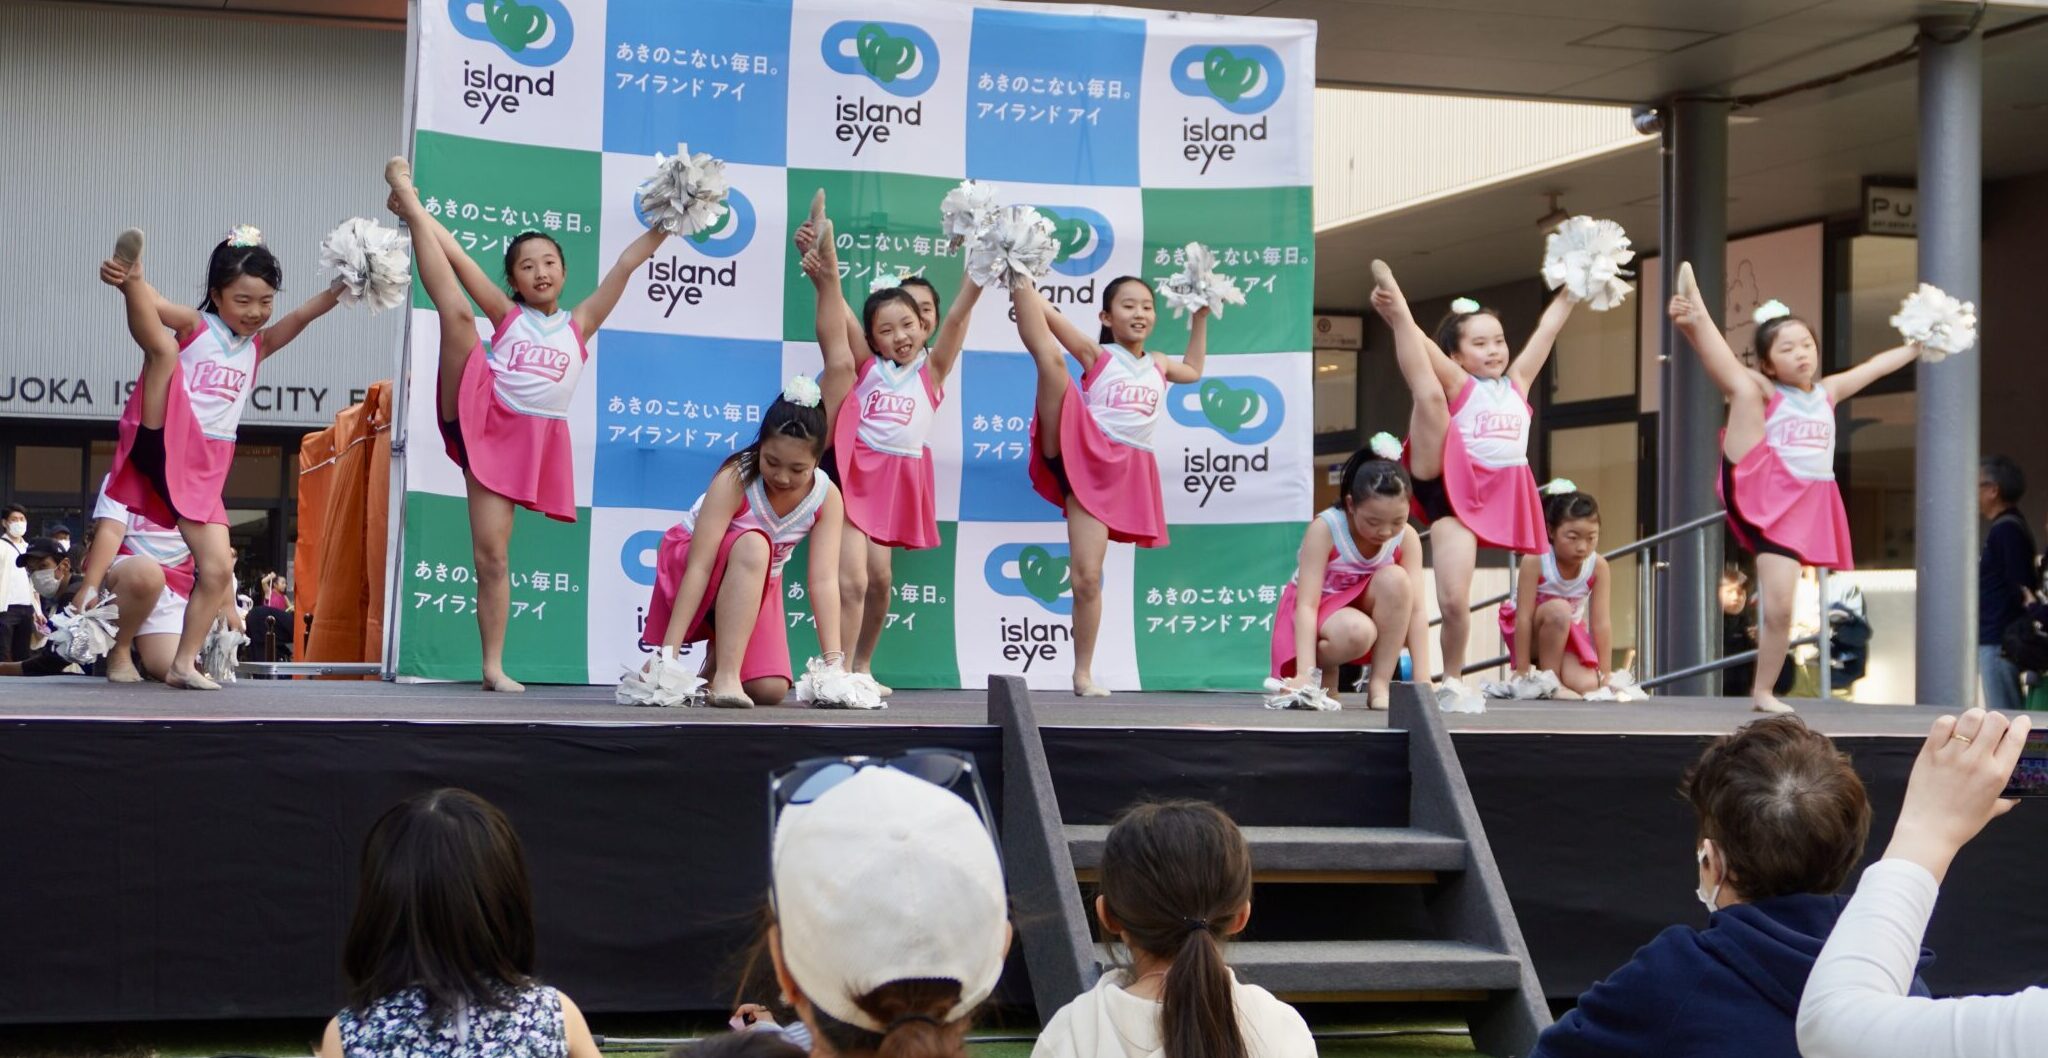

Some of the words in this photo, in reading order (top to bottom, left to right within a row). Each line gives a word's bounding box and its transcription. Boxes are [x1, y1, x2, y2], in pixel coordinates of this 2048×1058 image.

[616, 42, 778, 76] あきのこない毎日。
[463, 60, 555, 97] island
[615, 72, 705, 98] アイランド
[711, 82, 745, 101] アイ
[977, 72, 1132, 99] あきのこない毎日。
[463, 90, 520, 125] eye
[836, 95, 922, 126] island
[977, 102, 1060, 124] アイランド
[1068, 107, 1101, 125] アイ
[835, 123, 890, 157] eye
[1183, 116, 1267, 142] island
[1183, 144, 1235, 175] eye
[425, 196, 592, 233] あきのこない毎日。
[836, 232, 957, 258] のこない毎日。
[1154, 247, 1308, 266] あきこない毎日。
[647, 254, 737, 287] island
[647, 283, 703, 318] eye
[508, 340, 571, 372] Fave
[251, 385, 328, 413] CITY
[608, 395, 760, 423] あきのこない毎日
[863, 390, 916, 419] Fave
[1106, 380, 1159, 409] Fave
[608, 424, 698, 447] アイランド
[704, 431, 739, 450] アイ
[1473, 410, 1522, 439] Fave
[1780, 417, 1831, 445] Fave
[973, 441, 1031, 459] アイラ
[1184, 447, 1269, 473] island
[1184, 475, 1236, 508] eye
[414, 560, 580, 593] あきのい毎日。
[413, 591, 478, 614] アイラ
[511, 601, 547, 621] アイ
[1146, 584, 1287, 606] あきのこない毎
[1146, 613, 1233, 634] アイランド
[1239, 613, 1274, 632] アイ
[1002, 643, 1058, 673] eye
